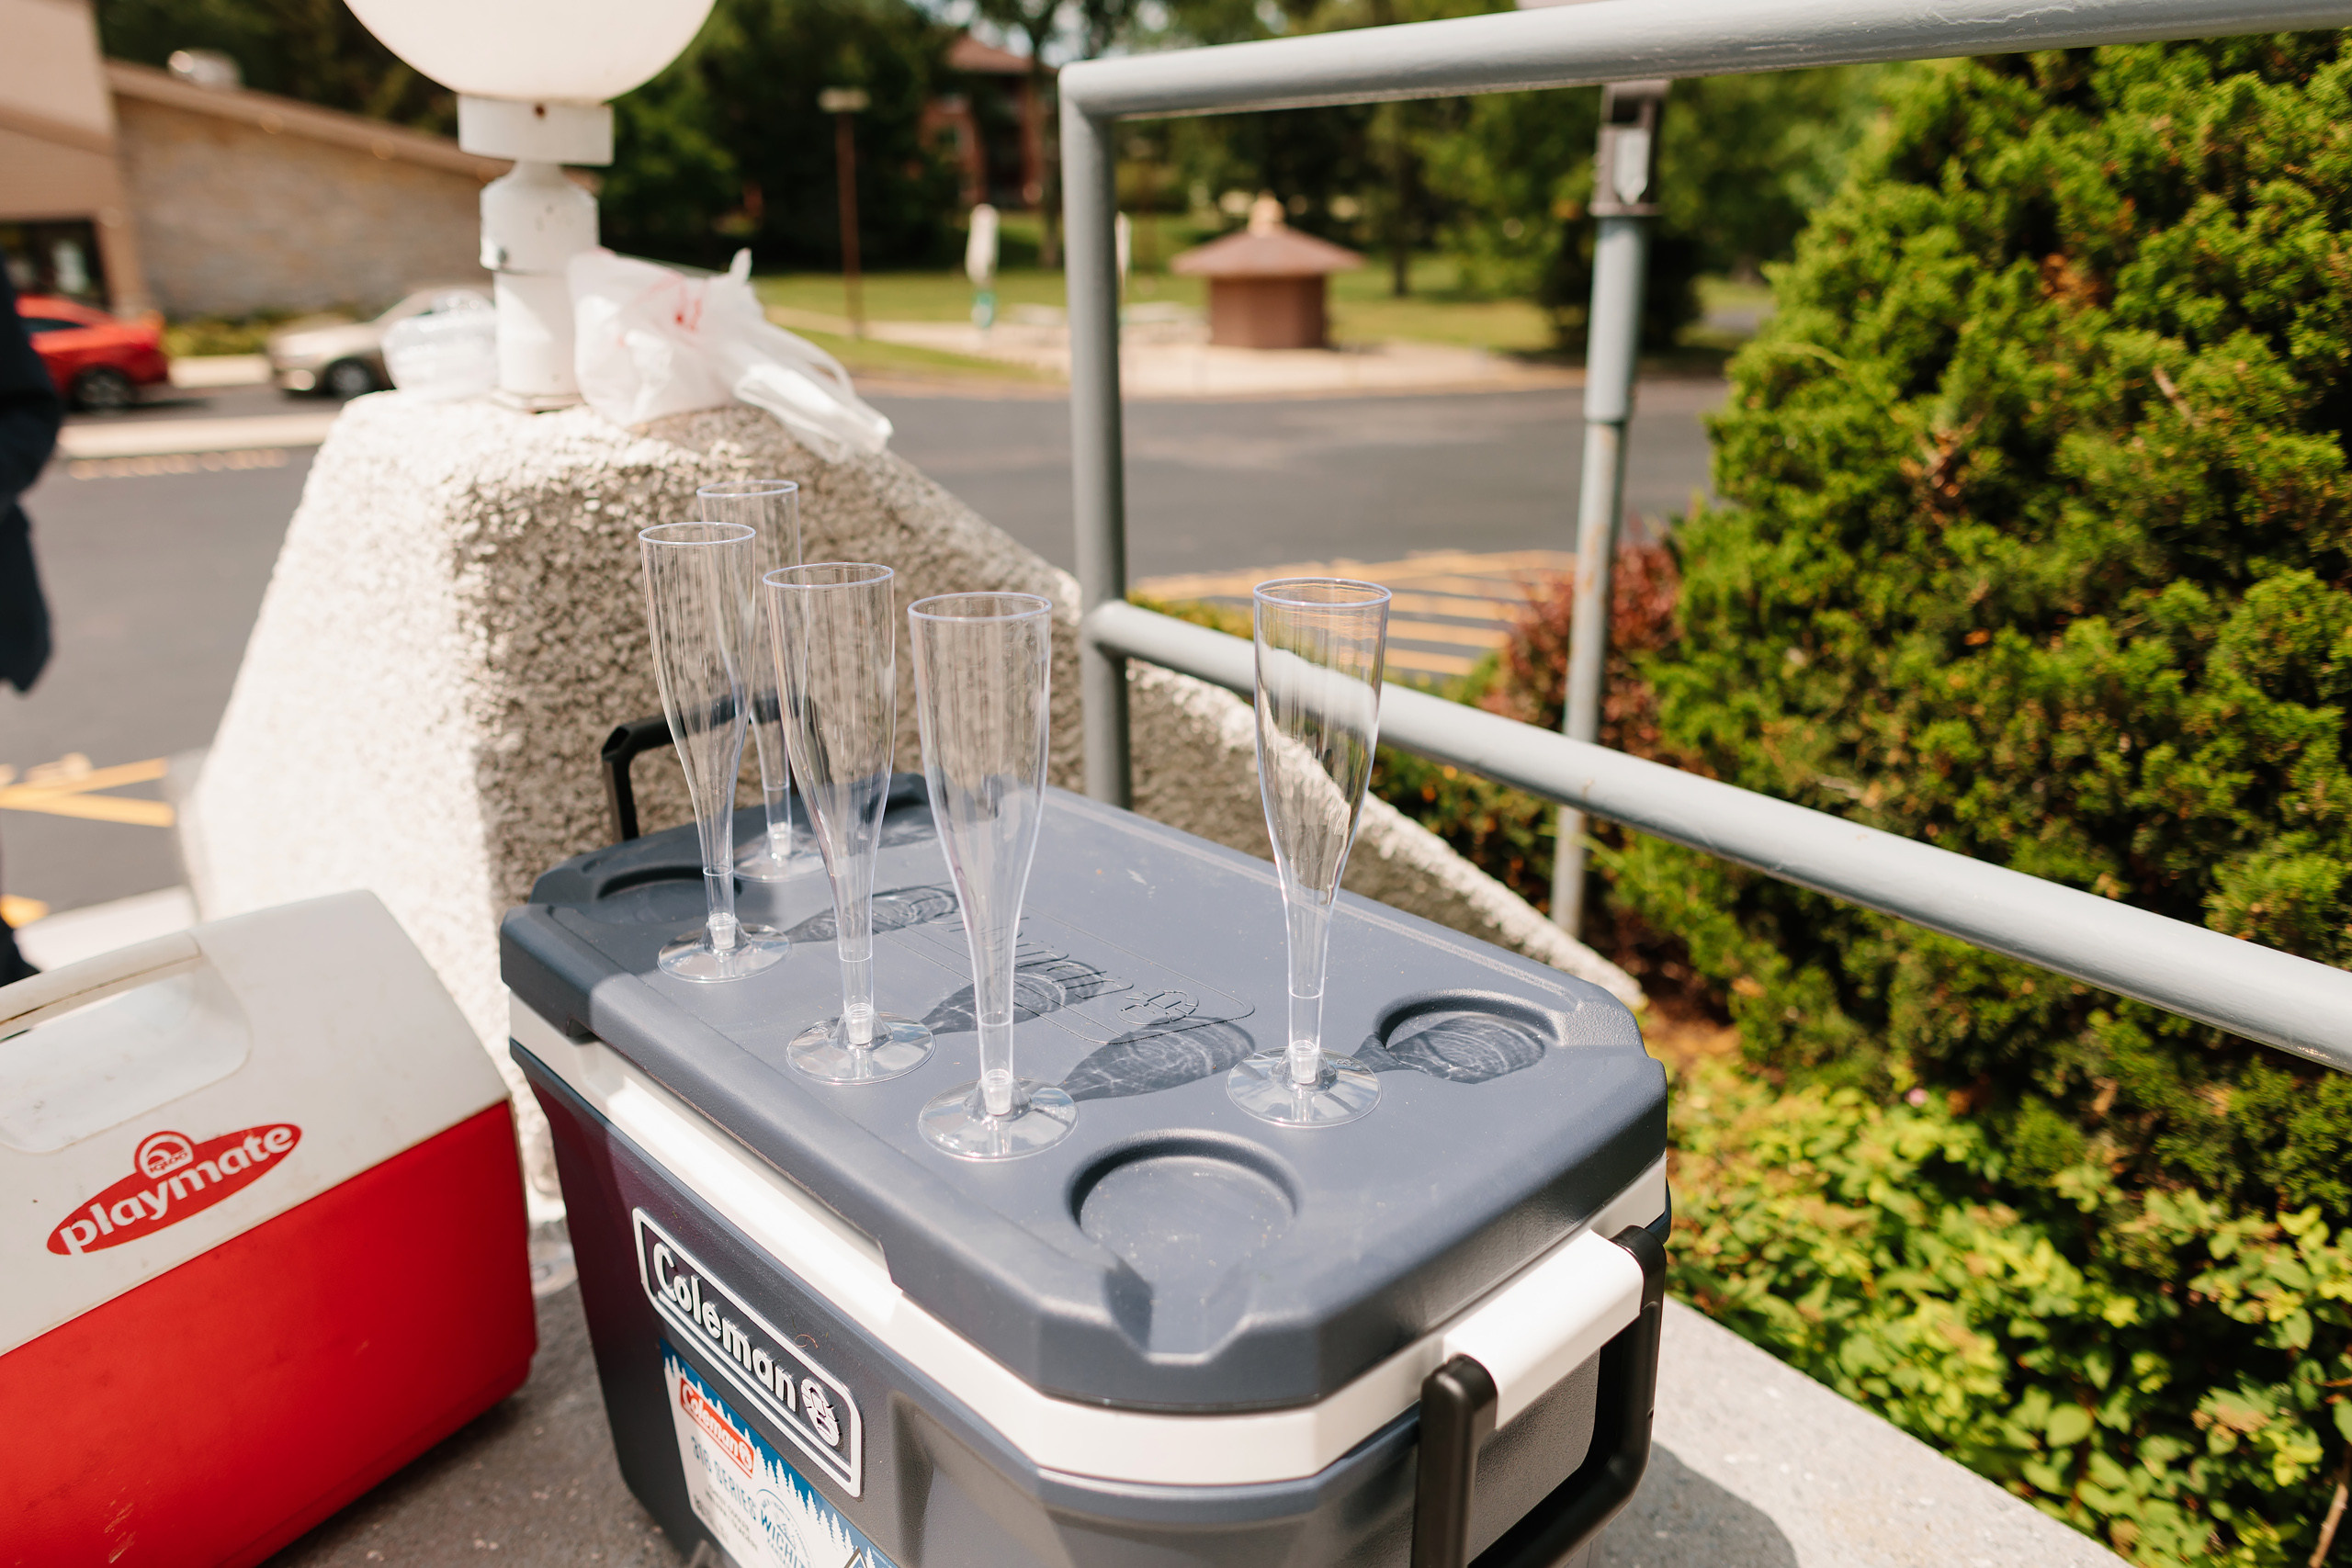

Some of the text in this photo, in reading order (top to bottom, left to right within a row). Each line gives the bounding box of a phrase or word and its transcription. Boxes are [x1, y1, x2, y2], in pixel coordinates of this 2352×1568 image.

[59, 1125, 294, 1255] playmate
[652, 1241, 797, 1413] Coleman
[682, 1382, 740, 1458] Coleman
[714, 1459, 757, 1522] SERIES
